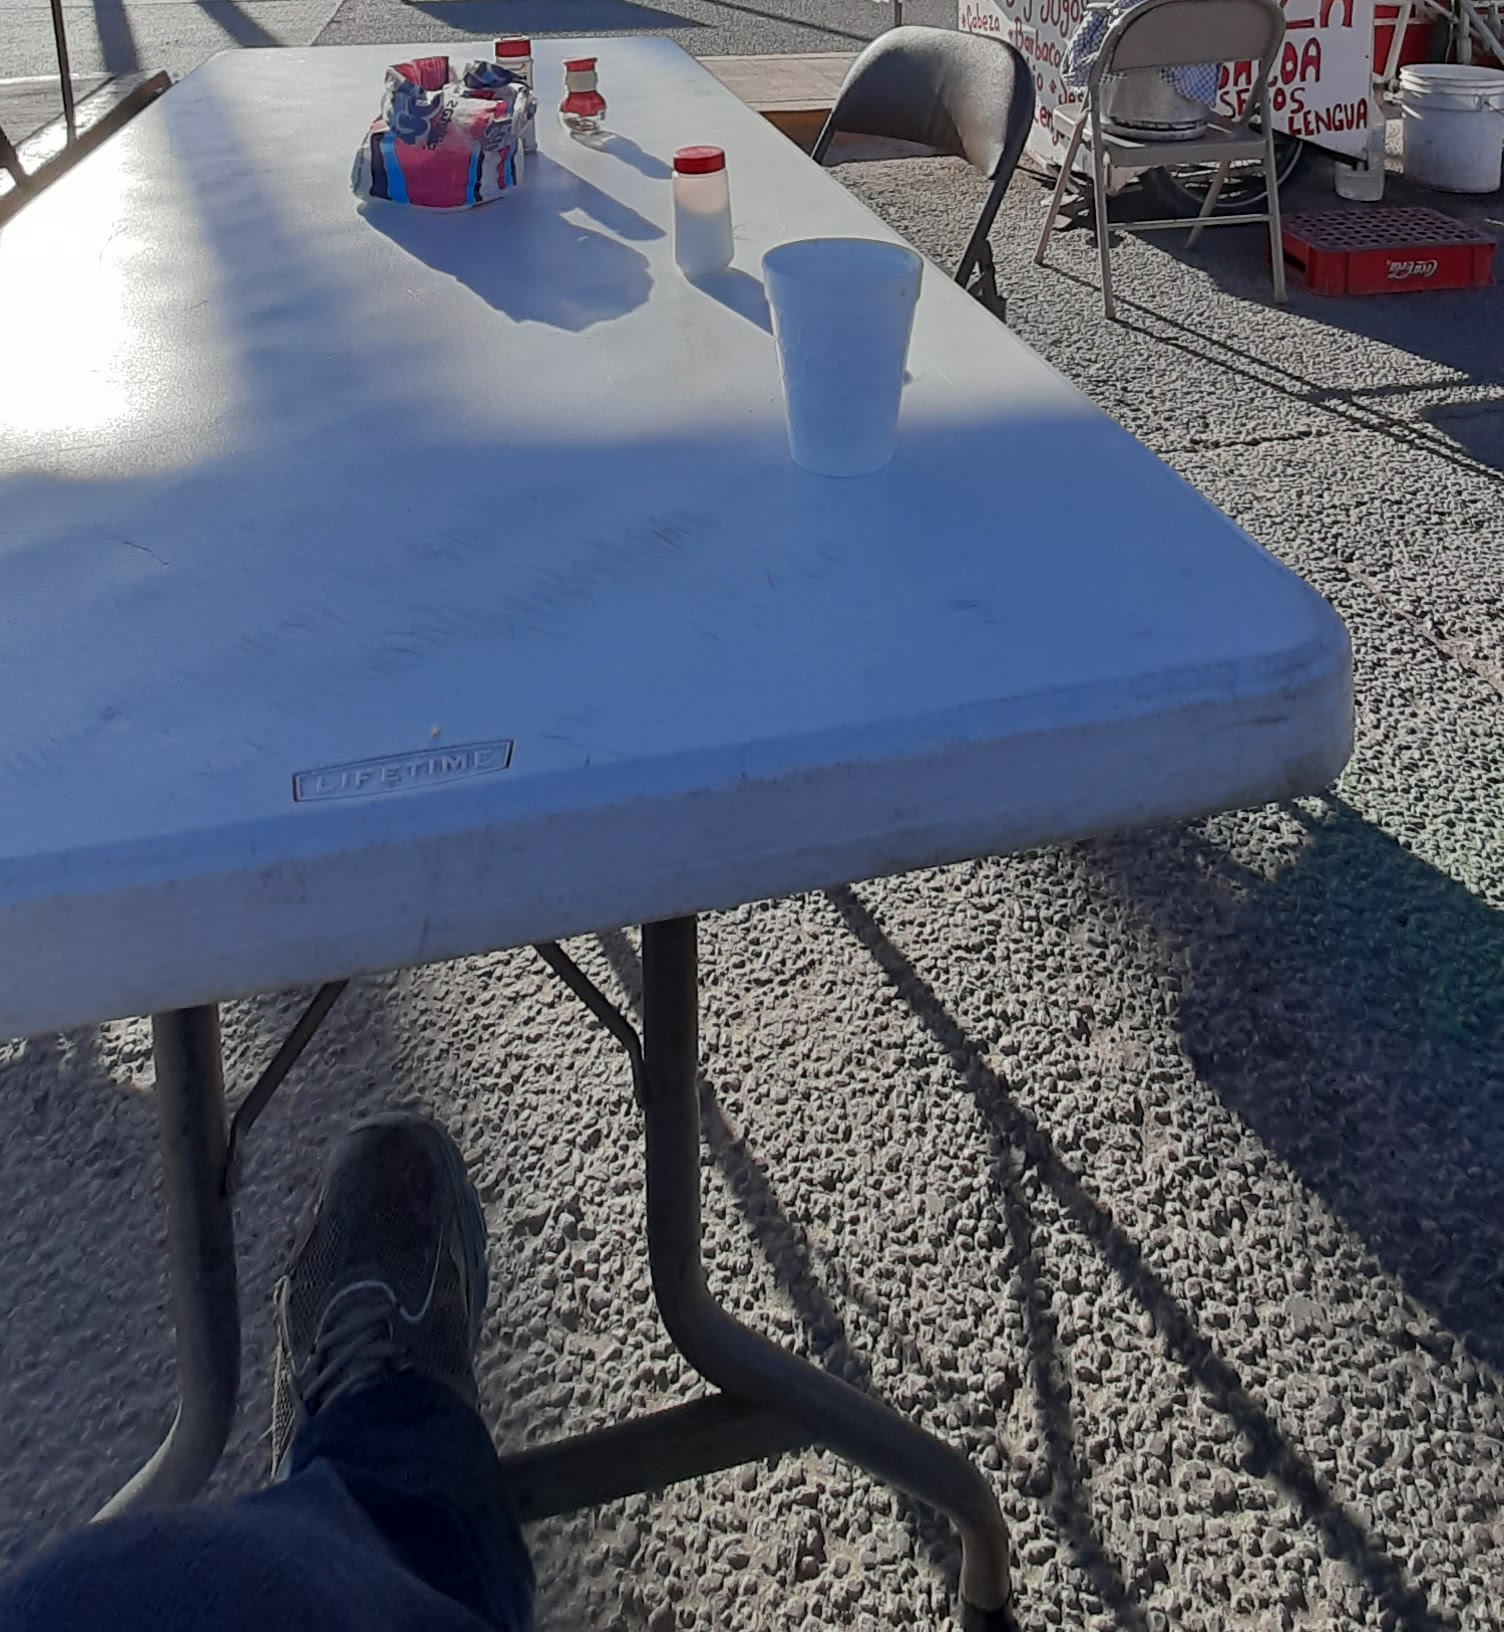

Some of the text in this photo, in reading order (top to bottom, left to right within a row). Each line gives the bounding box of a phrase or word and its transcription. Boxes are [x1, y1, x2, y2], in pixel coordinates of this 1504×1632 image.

[1013, 16, 1062, 68] Barbaco
[1288, 98, 1368, 136] LENGUA
[315, 748, 493, 794] LIFETIME
